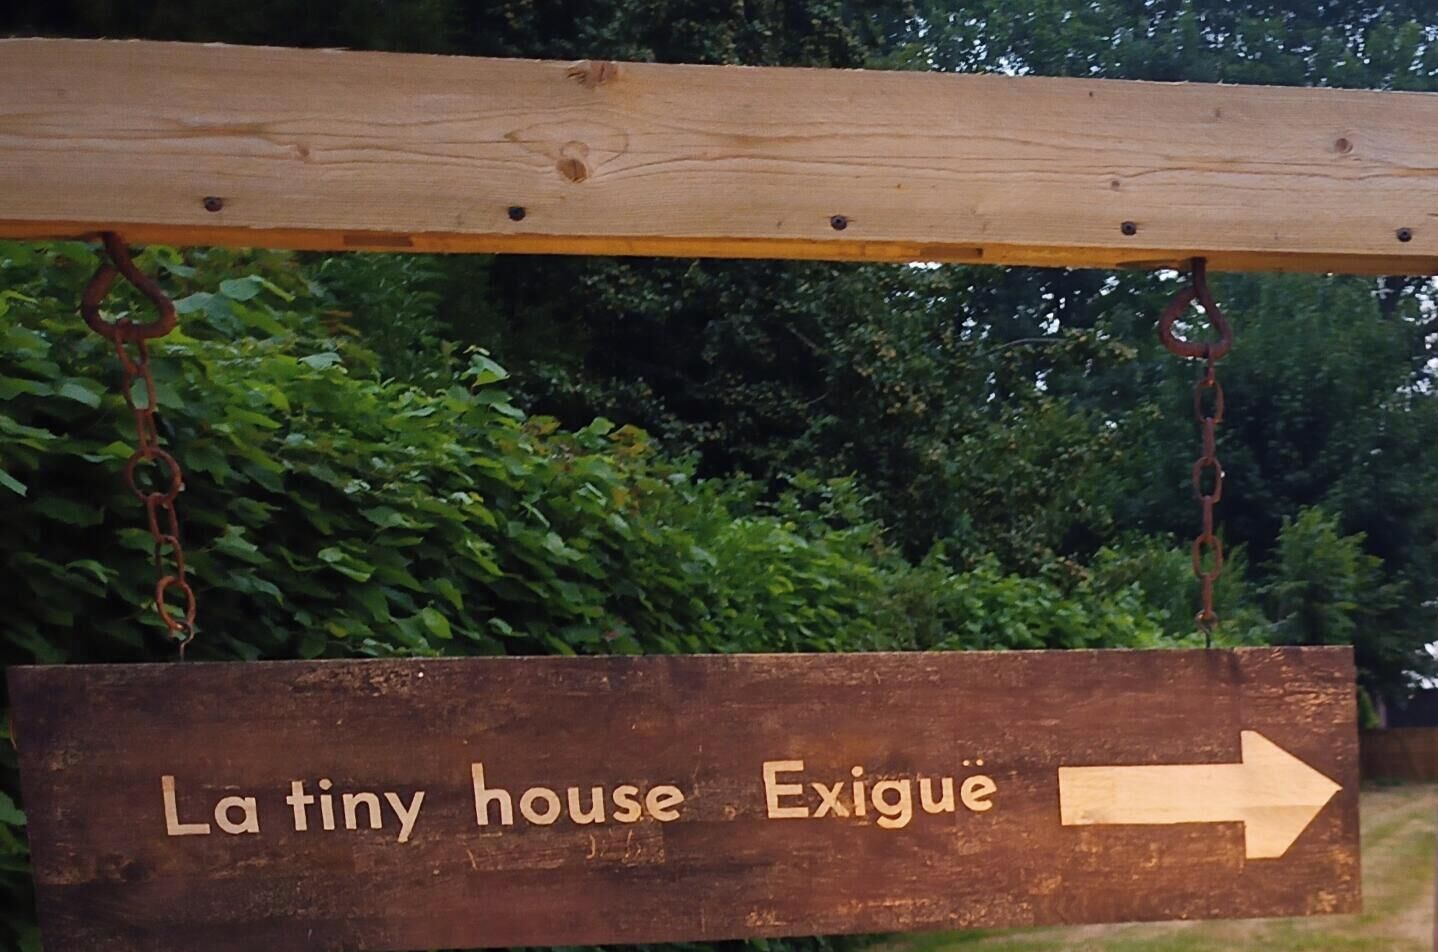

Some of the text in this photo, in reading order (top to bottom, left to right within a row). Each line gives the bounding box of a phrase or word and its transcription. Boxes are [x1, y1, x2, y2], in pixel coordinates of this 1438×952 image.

[161, 759, 998, 843] La tiny house Exiguë
